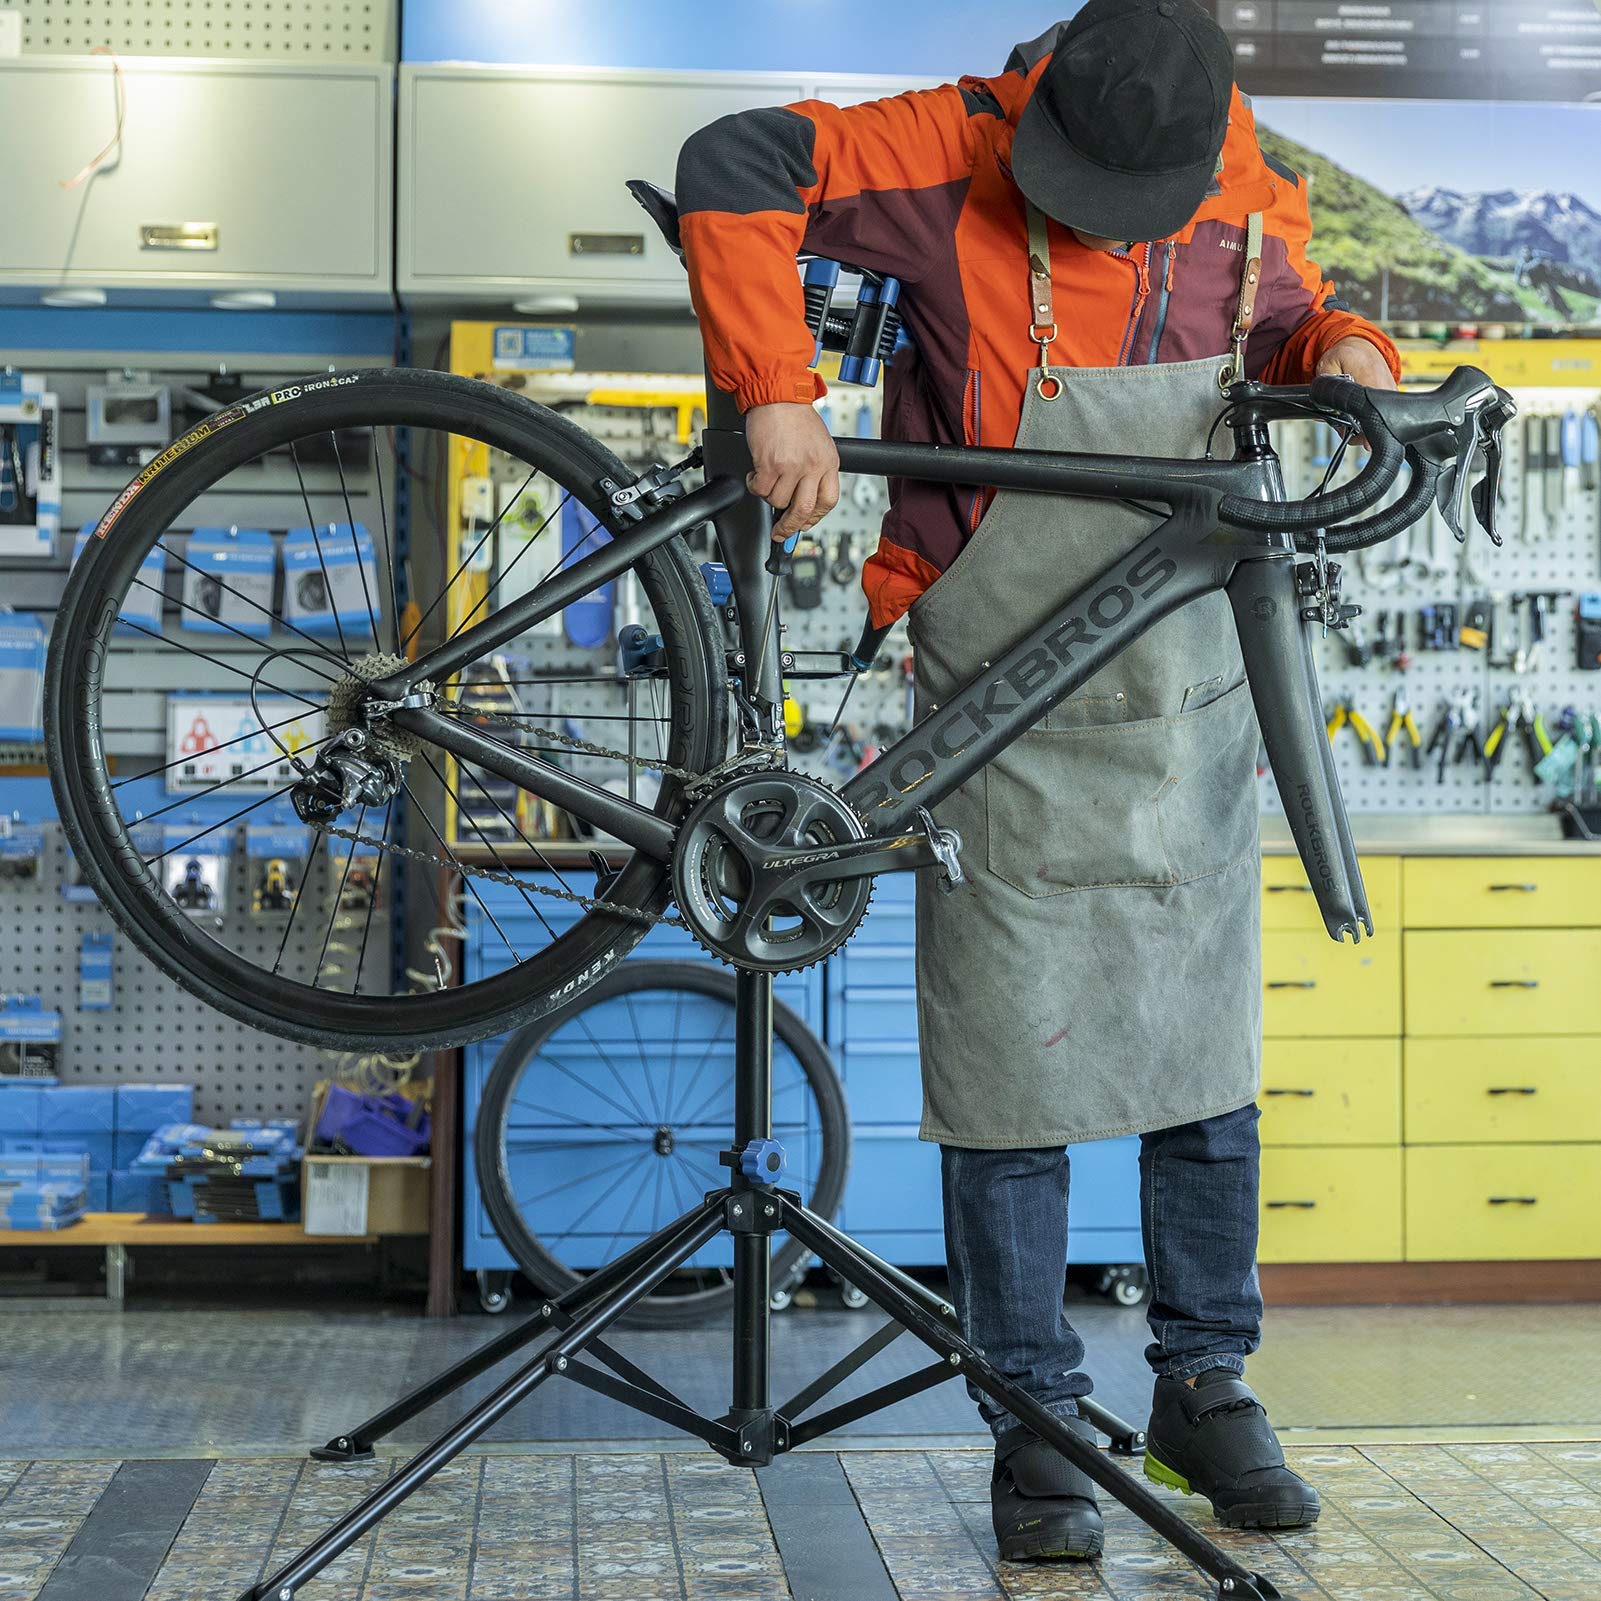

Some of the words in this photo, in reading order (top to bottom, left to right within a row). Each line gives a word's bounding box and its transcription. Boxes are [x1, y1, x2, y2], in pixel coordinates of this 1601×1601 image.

[1219, 239, 1244, 252] AIMU
[97, 482, 140, 536] KENDA
[140, 424, 210, 484] KRITERIUM
[275, 386, 301, 402] PRO
[851, 546, 1177, 823] ROCKBROS
[762, 851, 840, 869] ULTEGRA
[1297, 783, 1336, 892] ROCKBROS
[549, 948, 615, 1001] KENDA
